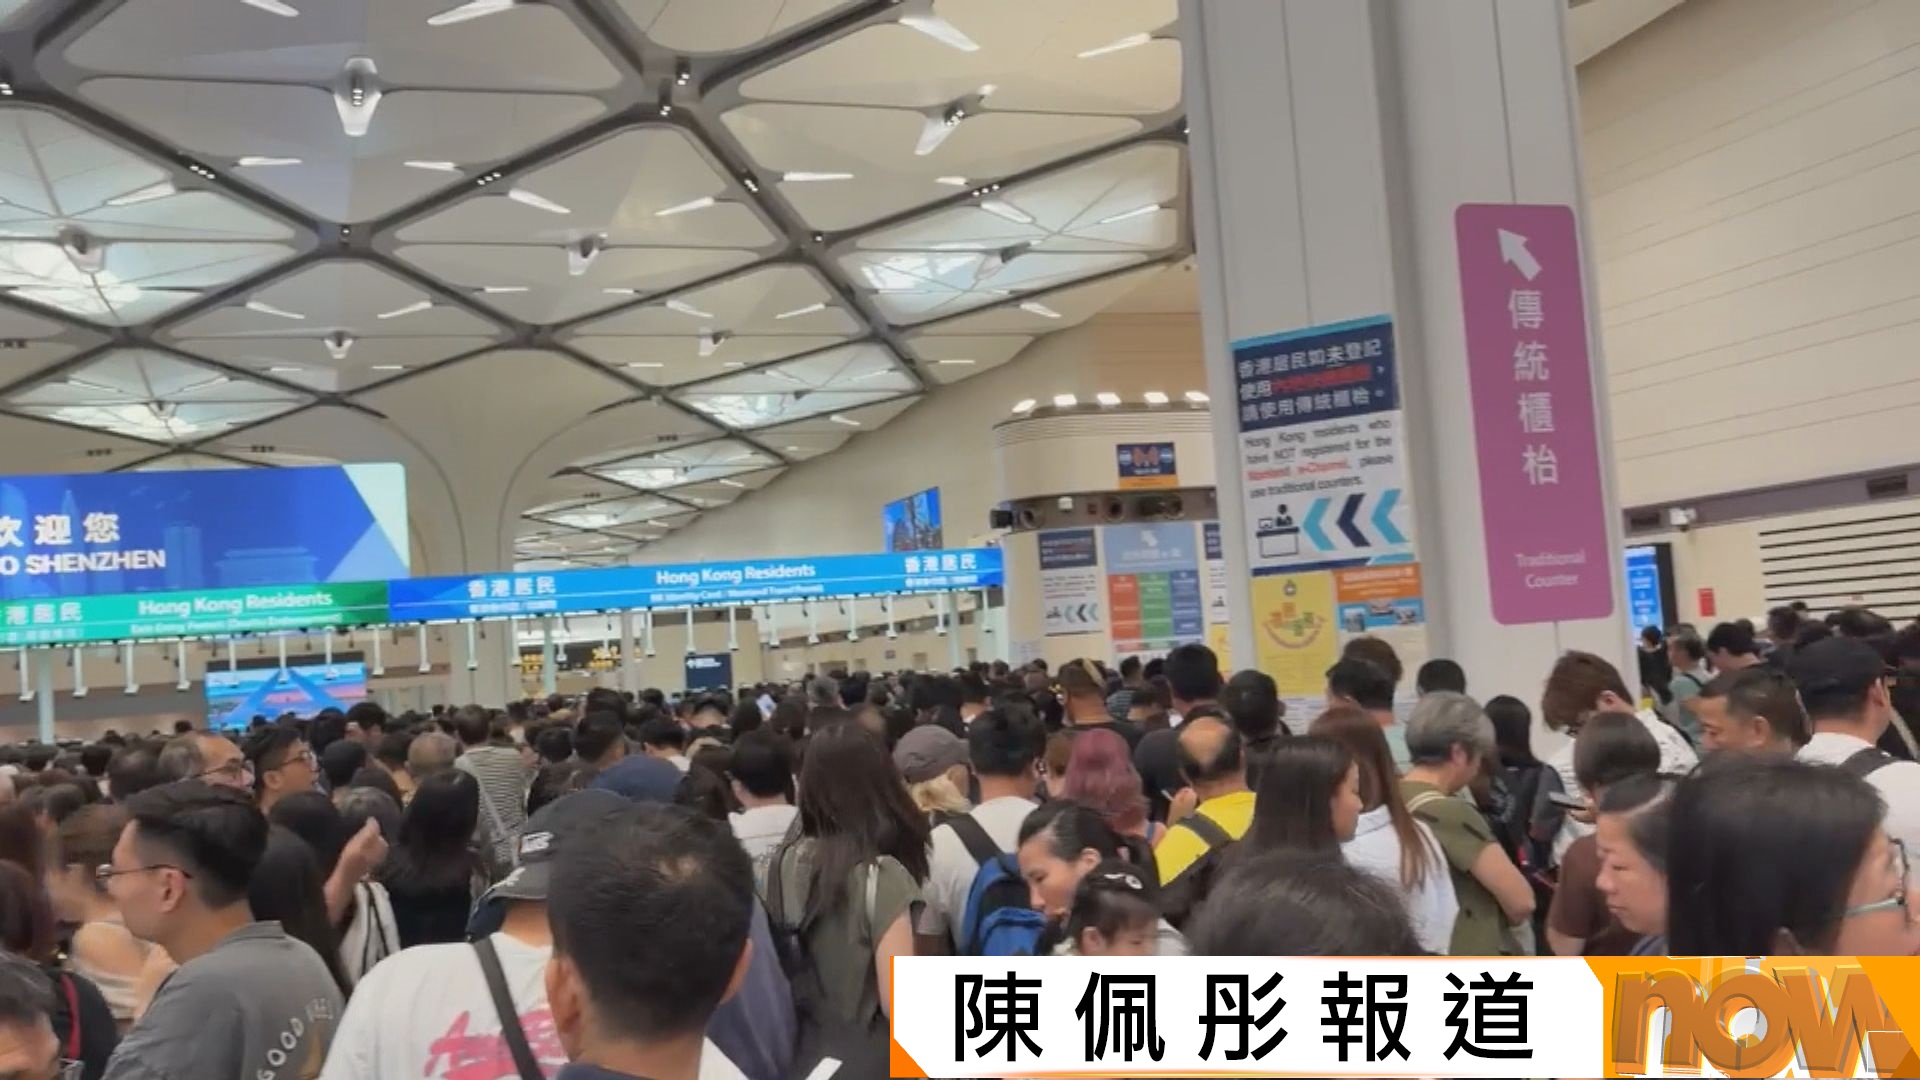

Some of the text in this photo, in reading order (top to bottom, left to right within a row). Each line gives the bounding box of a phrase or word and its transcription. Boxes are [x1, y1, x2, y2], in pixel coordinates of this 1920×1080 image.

[1507, 288, 1559, 486] 傳統櫃枱
[1278, 432, 1306, 443] Kong
[1274, 447, 1296, 460] NOT
[0, 549, 166, 576] O SHENZHEN
[1514, 549, 1587, 568] Traditional
[468, 576, 556, 598] 香港居民
[656, 564, 815, 588] Hong Kong Residents
[1525, 574, 1579, 588] Counter
[0, 602, 82, 626] 港居民
[138, 592, 333, 618] Hong Kong Residents
[257, 1016, 304, 1080] GOOD
